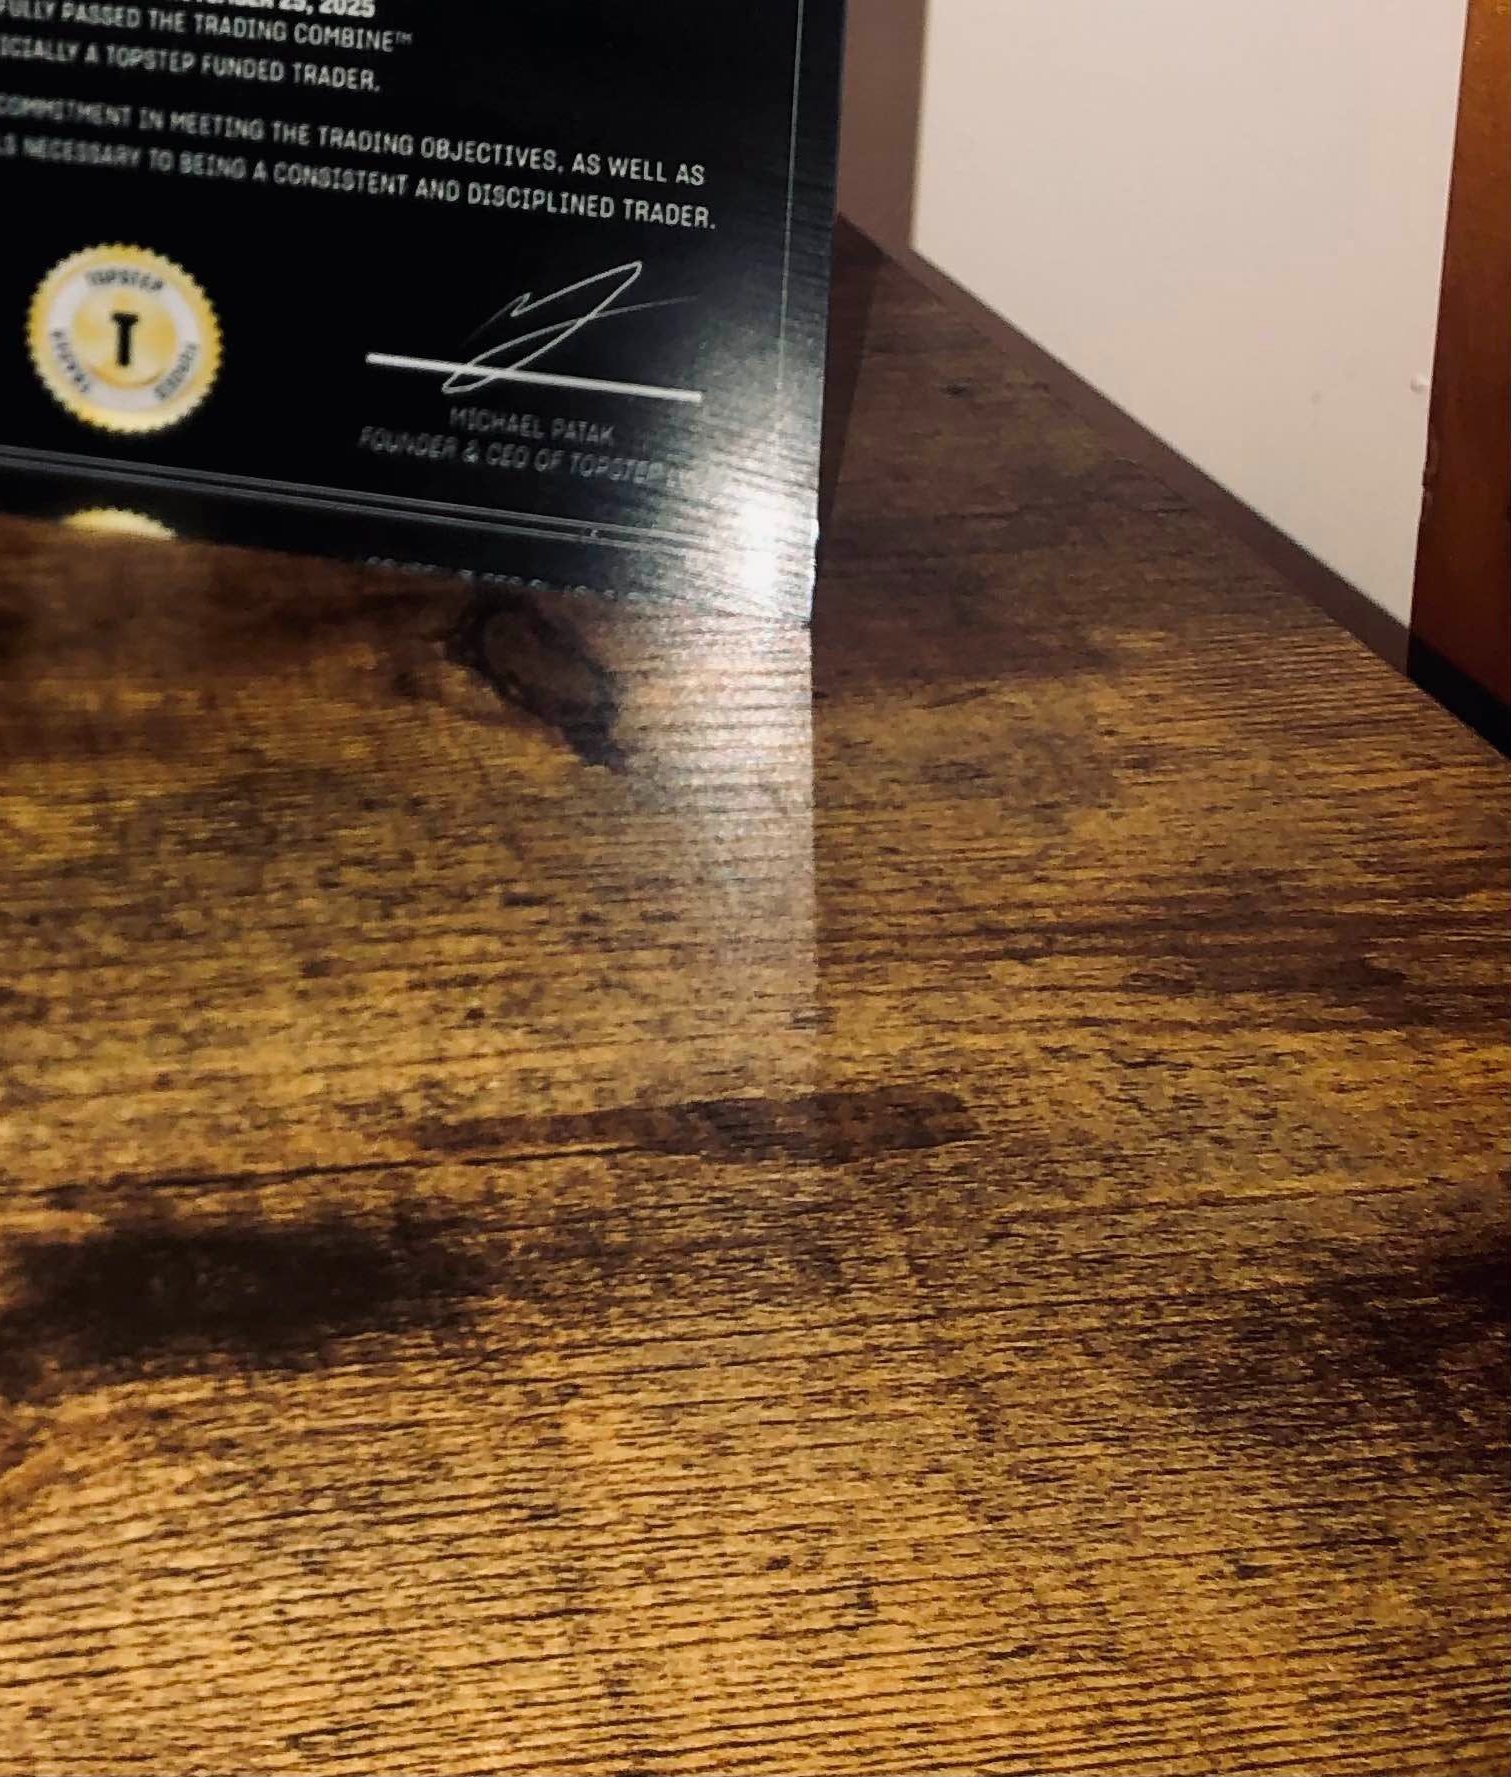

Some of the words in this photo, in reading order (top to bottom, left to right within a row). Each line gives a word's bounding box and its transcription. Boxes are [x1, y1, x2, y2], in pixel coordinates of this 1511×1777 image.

[61, 0, 141, 30] PASSED
[149, 8, 187, 34] THE
[193, 12, 287, 43] TRADING
[84, 43, 100, 65] A
[106, 44, 195, 75] TOPSTEP
[201, 53, 285, 83] FUNDED
[290, 62, 381, 94] TRADER.
[138, 106, 166, 131] IN
[170, 110, 266, 143] MEETING
[272, 121, 311, 147] THE
[317, 126, 415, 158] TRADING
[420, 136, 564, 175] OBJECTIVES,
[570, 152, 602, 177] AS
[607, 157, 669, 184] WELL
[674, 163, 706, 187] AS
[21, 134, 143, 170] NECESSARY
[148, 147, 174, 173] TO
[179, 150, 248, 182] BEING
[253, 158, 269, 183] A
[273, 161, 410, 199] CONSISTENT
[414, 175, 461, 203] AND
[467, 182, 615, 219] DISCIPLINED
[622, 198, 717, 231] TRADER.
[110, 311, 139, 367] T
[357, 425, 457, 461] FOUNDER
[484, 440, 529, 470] CEO
[533, 448, 566, 473] OF
[448, 404, 546, 441] MICHAEL
[550, 415, 616, 447] PATAK
